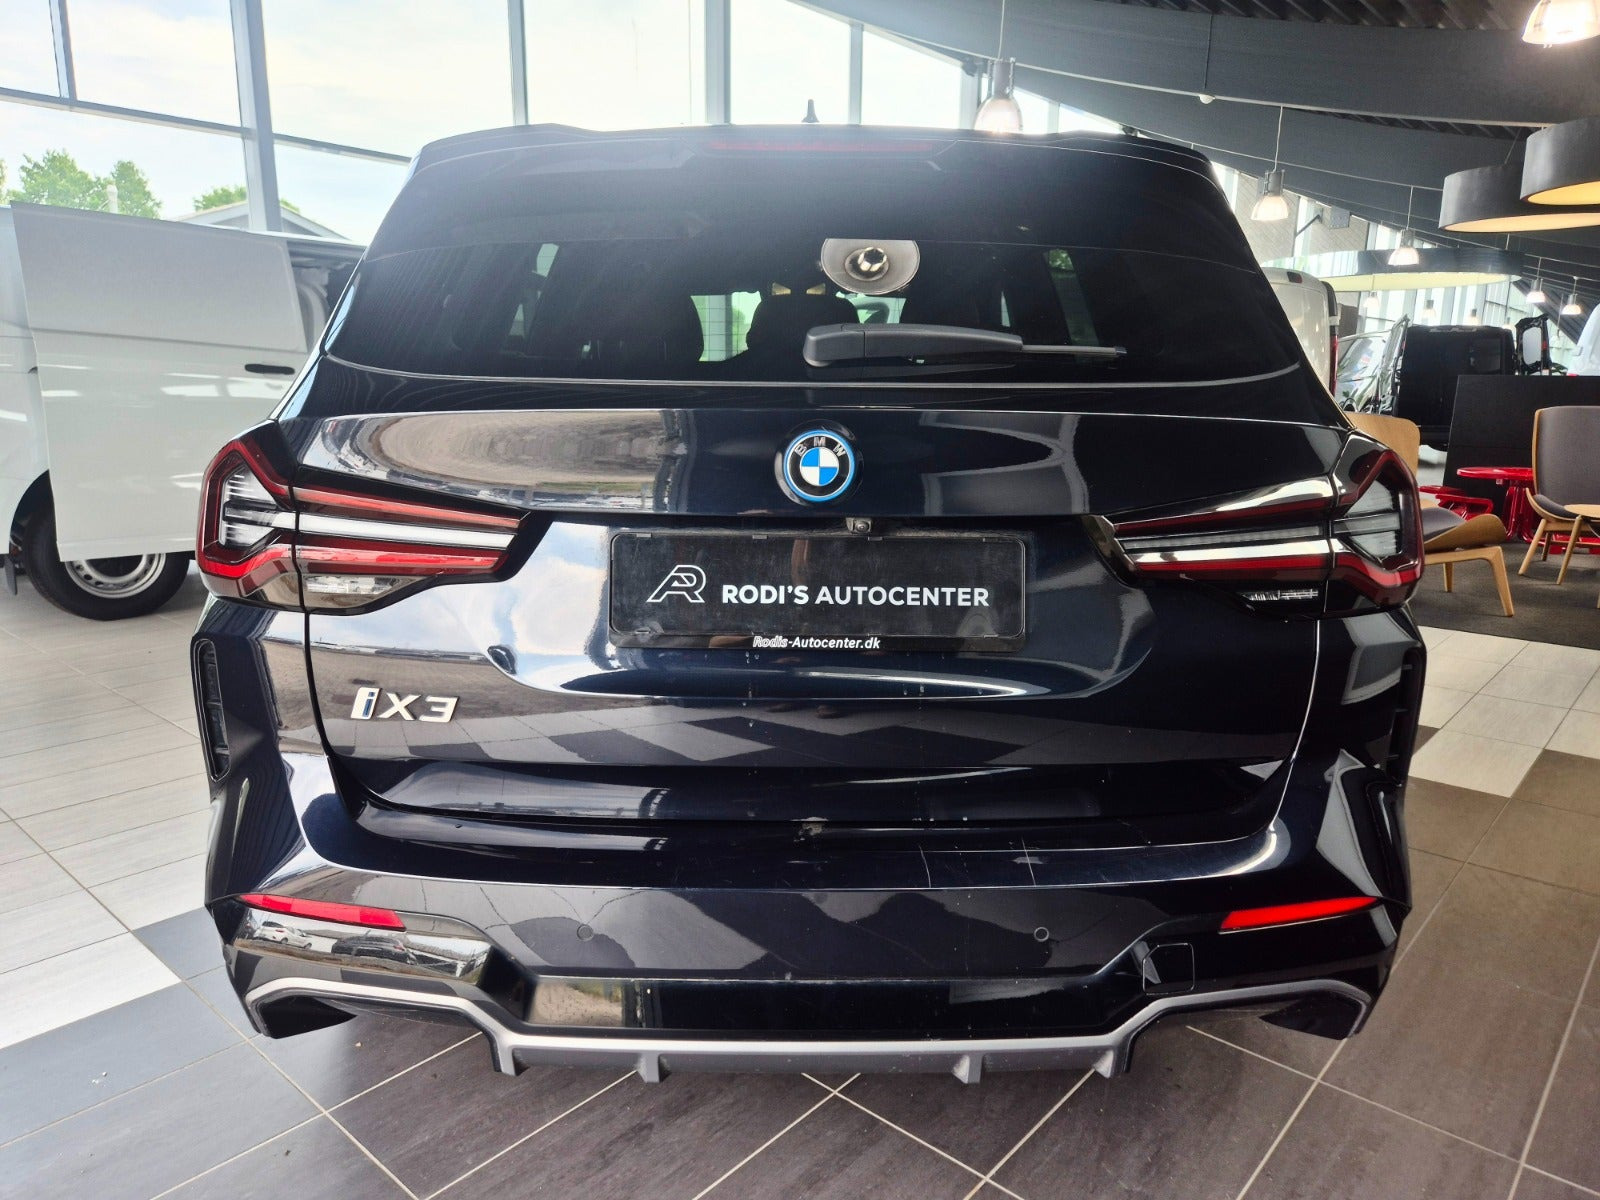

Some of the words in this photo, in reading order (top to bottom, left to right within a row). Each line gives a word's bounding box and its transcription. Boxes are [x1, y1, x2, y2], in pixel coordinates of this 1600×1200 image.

[794, 436, 846, 457] BMW
[722, 584, 809, 605] RODI'S
[815, 586, 989, 607] AUTOCENTER
[752, 635, 881, 649] Rodis-Autocenter.dk
[350, 687, 459, 723] iX3
